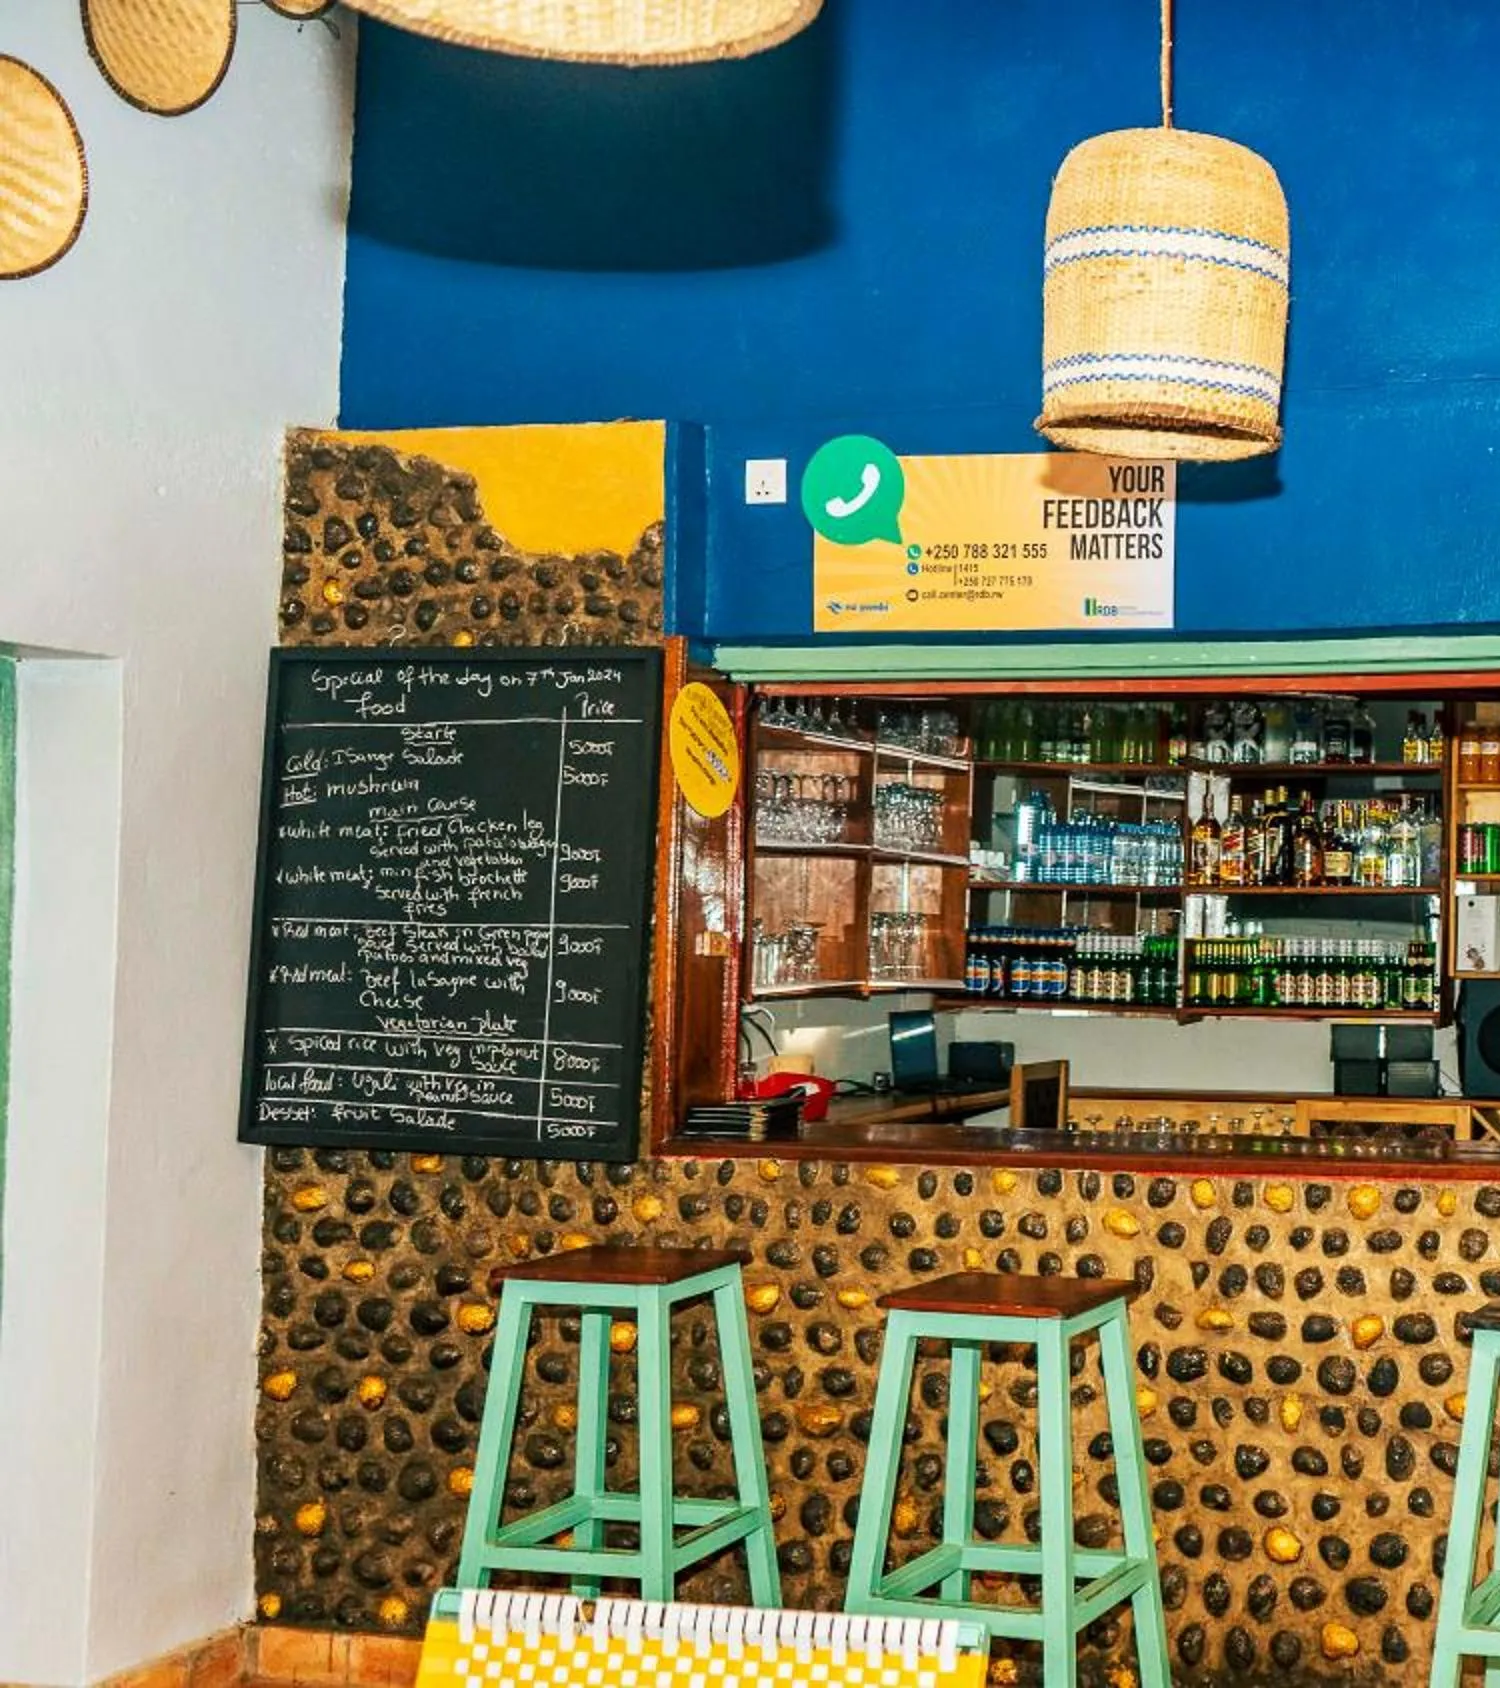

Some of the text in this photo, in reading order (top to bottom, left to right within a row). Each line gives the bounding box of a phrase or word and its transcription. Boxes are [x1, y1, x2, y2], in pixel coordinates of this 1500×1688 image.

[1109, 466, 1165, 493] YOUR
[1043, 500, 1163, 530] FEEDBACK
[925, 543, 1048, 560] +250 788 321 555
[1070, 533, 1164, 561] MATTERS
[922, 564, 953, 574] Hotline
[397, 665, 415, 693] of
[418, 665, 450, 687] the
[455, 666, 493, 697] day
[500, 675, 522, 687] on
[587, 668, 622, 684] 2024
[575, 691, 616, 719] Price
